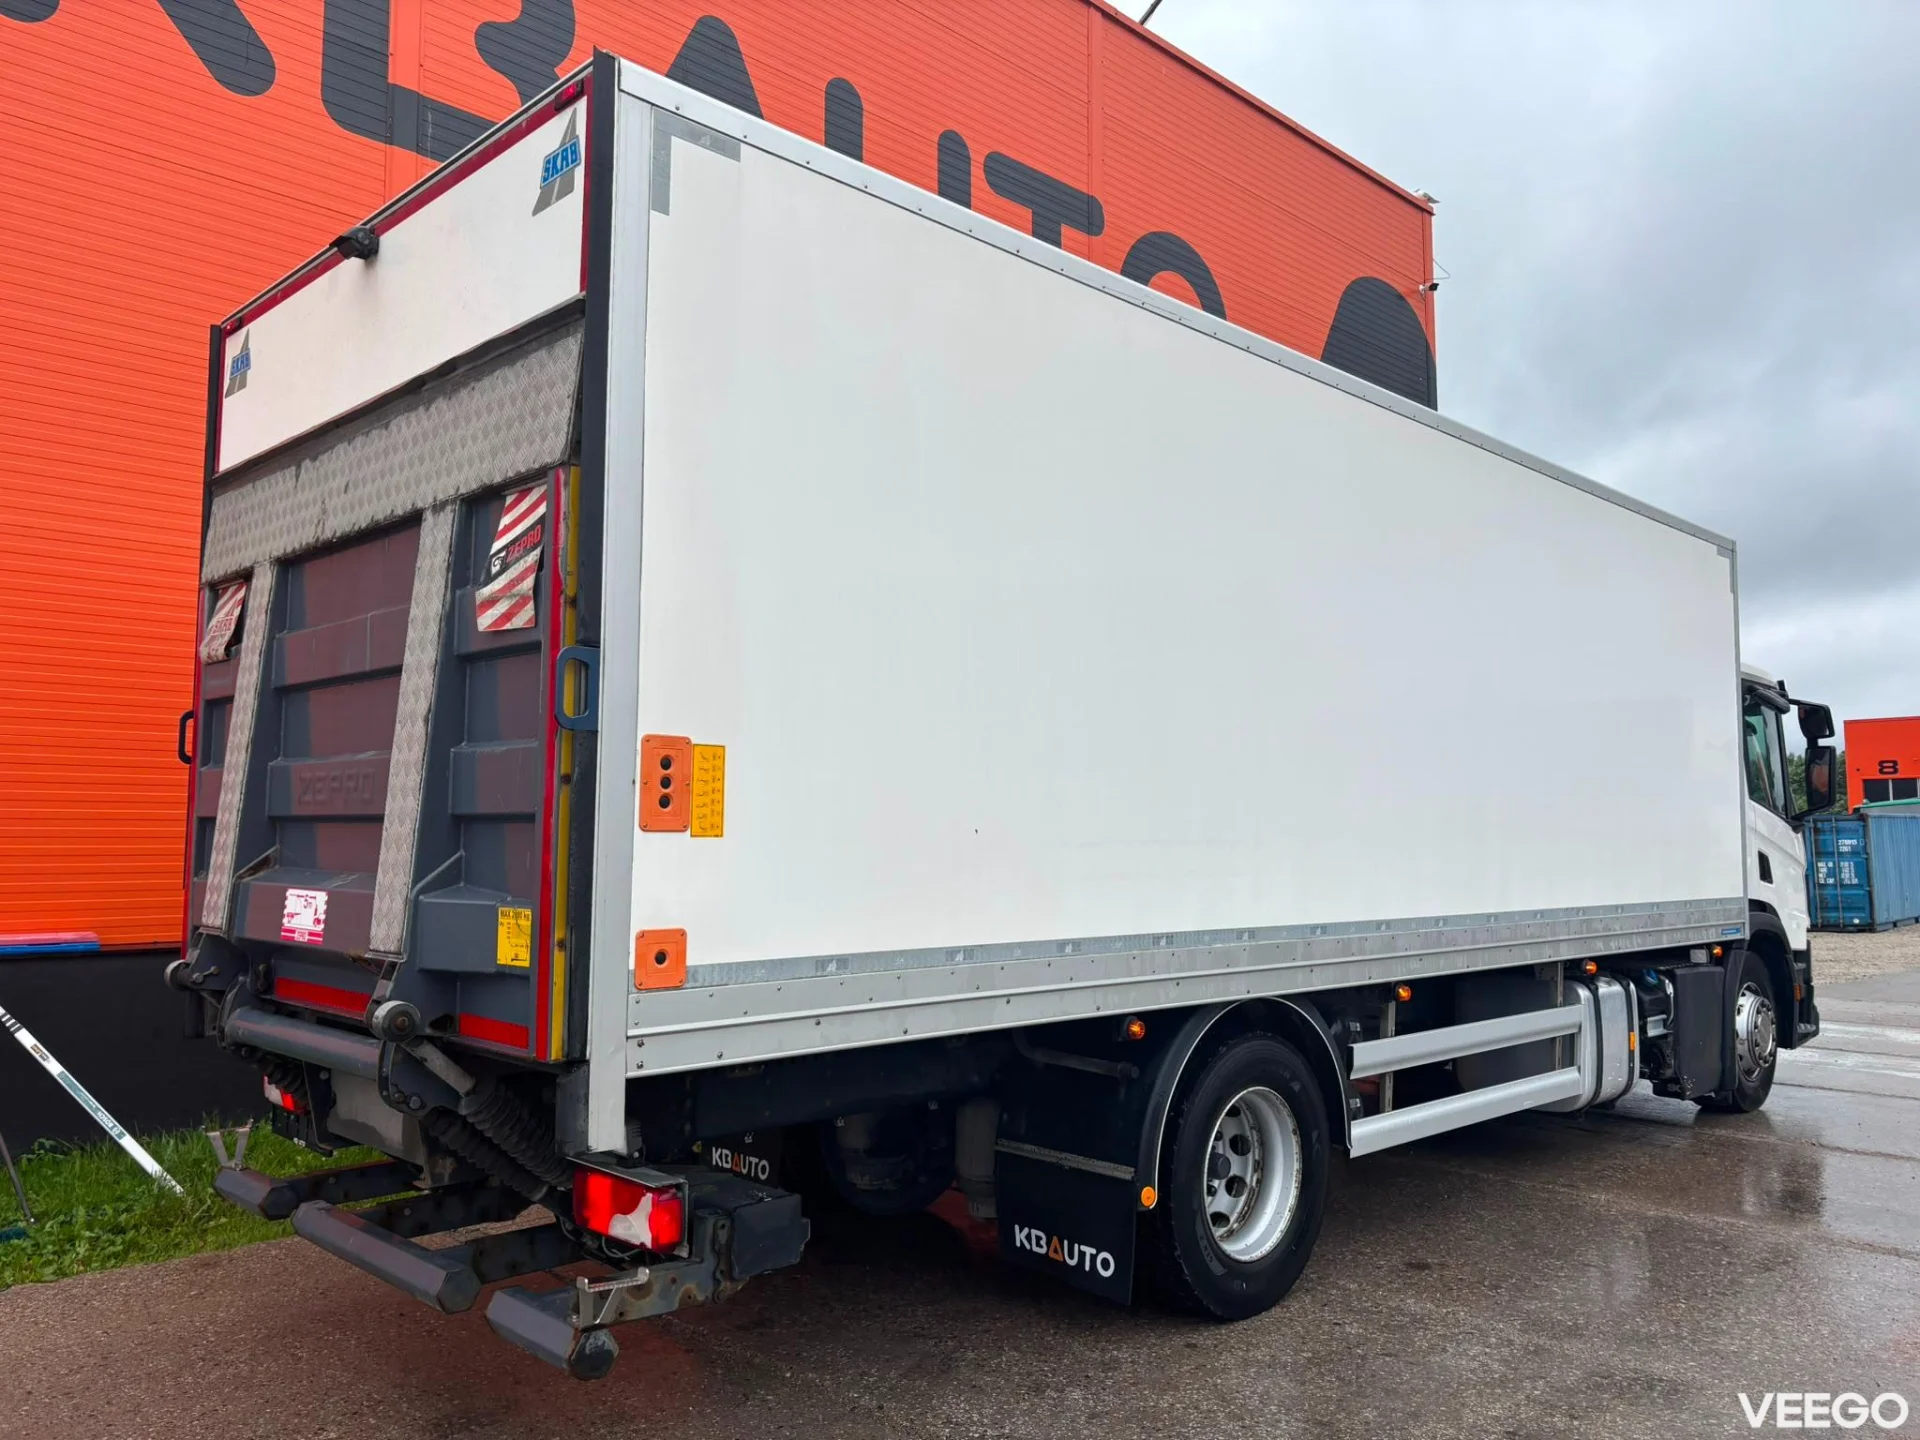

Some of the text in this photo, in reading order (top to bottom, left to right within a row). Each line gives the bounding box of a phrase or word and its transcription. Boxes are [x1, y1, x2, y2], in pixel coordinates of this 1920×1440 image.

[541, 139, 579, 185] SKAB
[506, 524, 542, 563] ZEPRO
[298, 767, 377, 807] ZEPRO
[1878, 760, 1899, 775] 8
[712, 1146, 769, 1181] KBAUTO
[1014, 1224, 1115, 1278] KBAUTO
